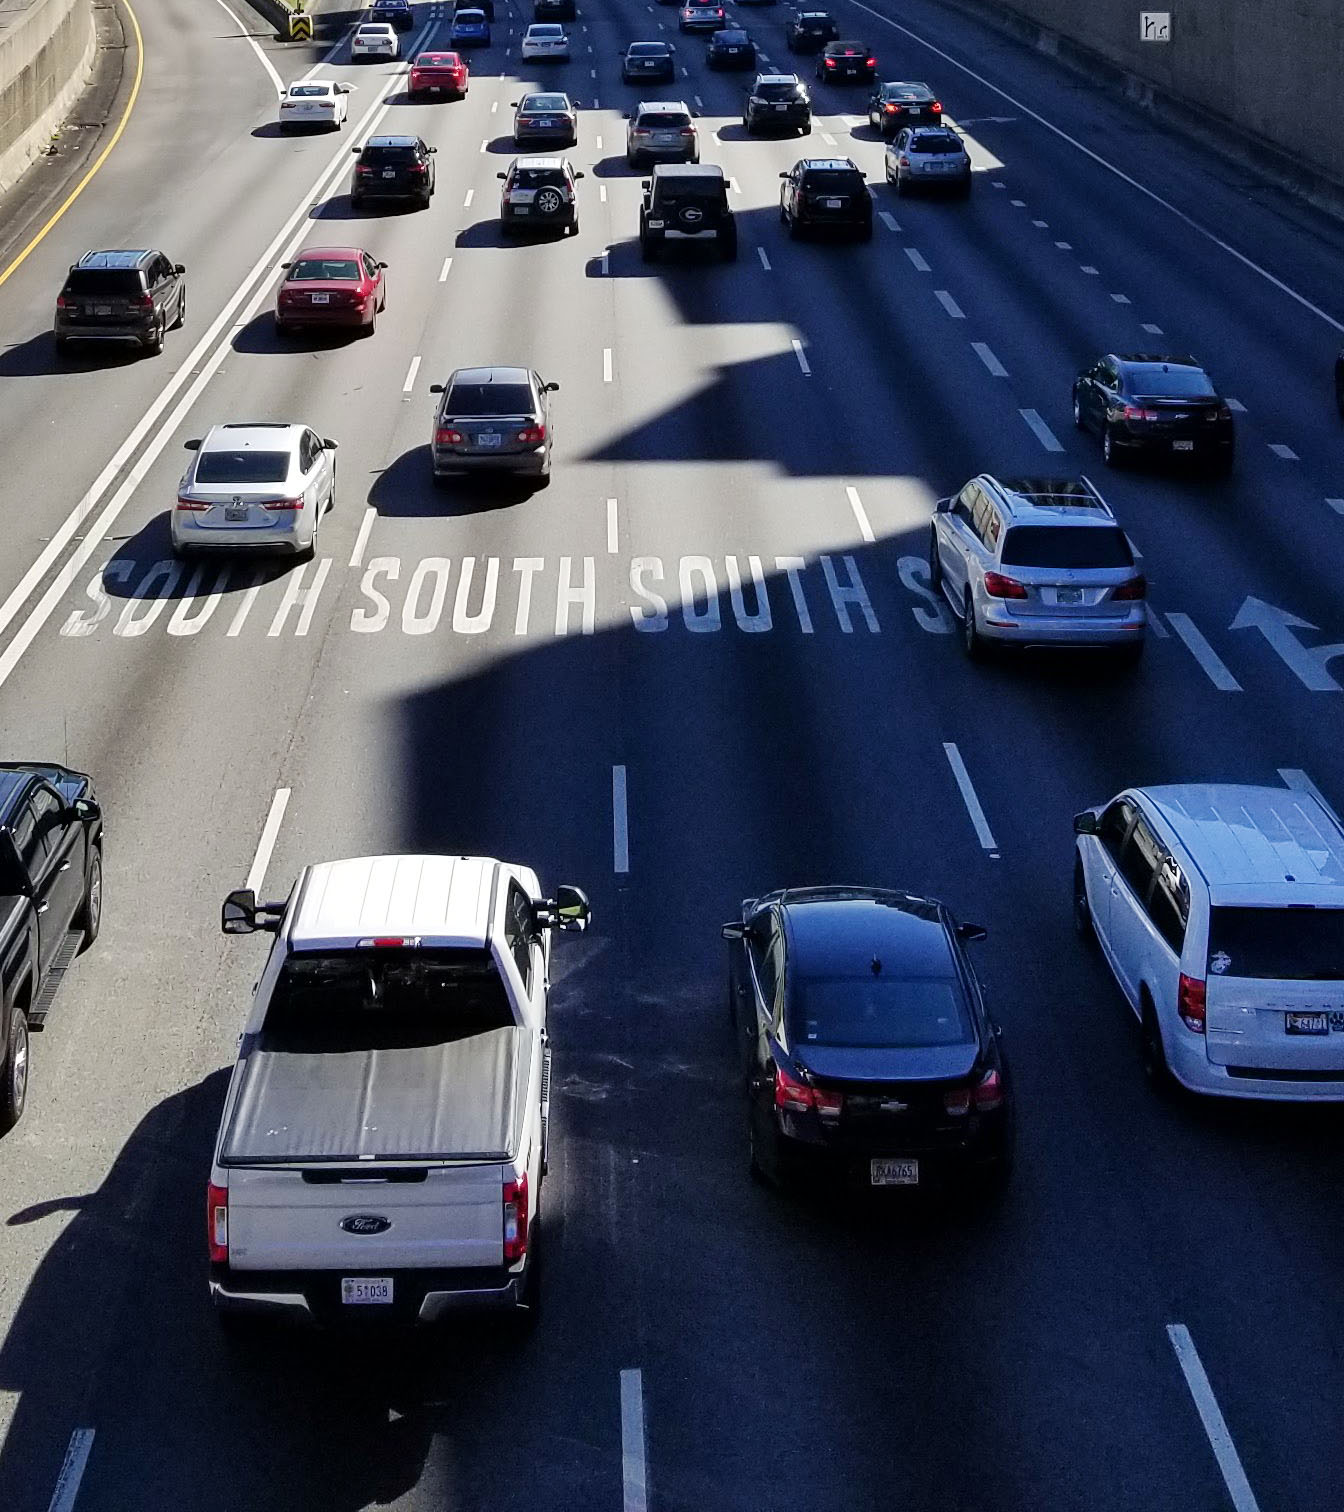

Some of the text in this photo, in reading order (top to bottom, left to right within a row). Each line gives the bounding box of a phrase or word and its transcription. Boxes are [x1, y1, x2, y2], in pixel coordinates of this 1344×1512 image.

[59, 557, 333, 637] SOUTH
[350, 556, 596, 635] SOUTH
[629, 555, 881, 634] SOUTH
[352, 1217, 380, 1230] Ford
